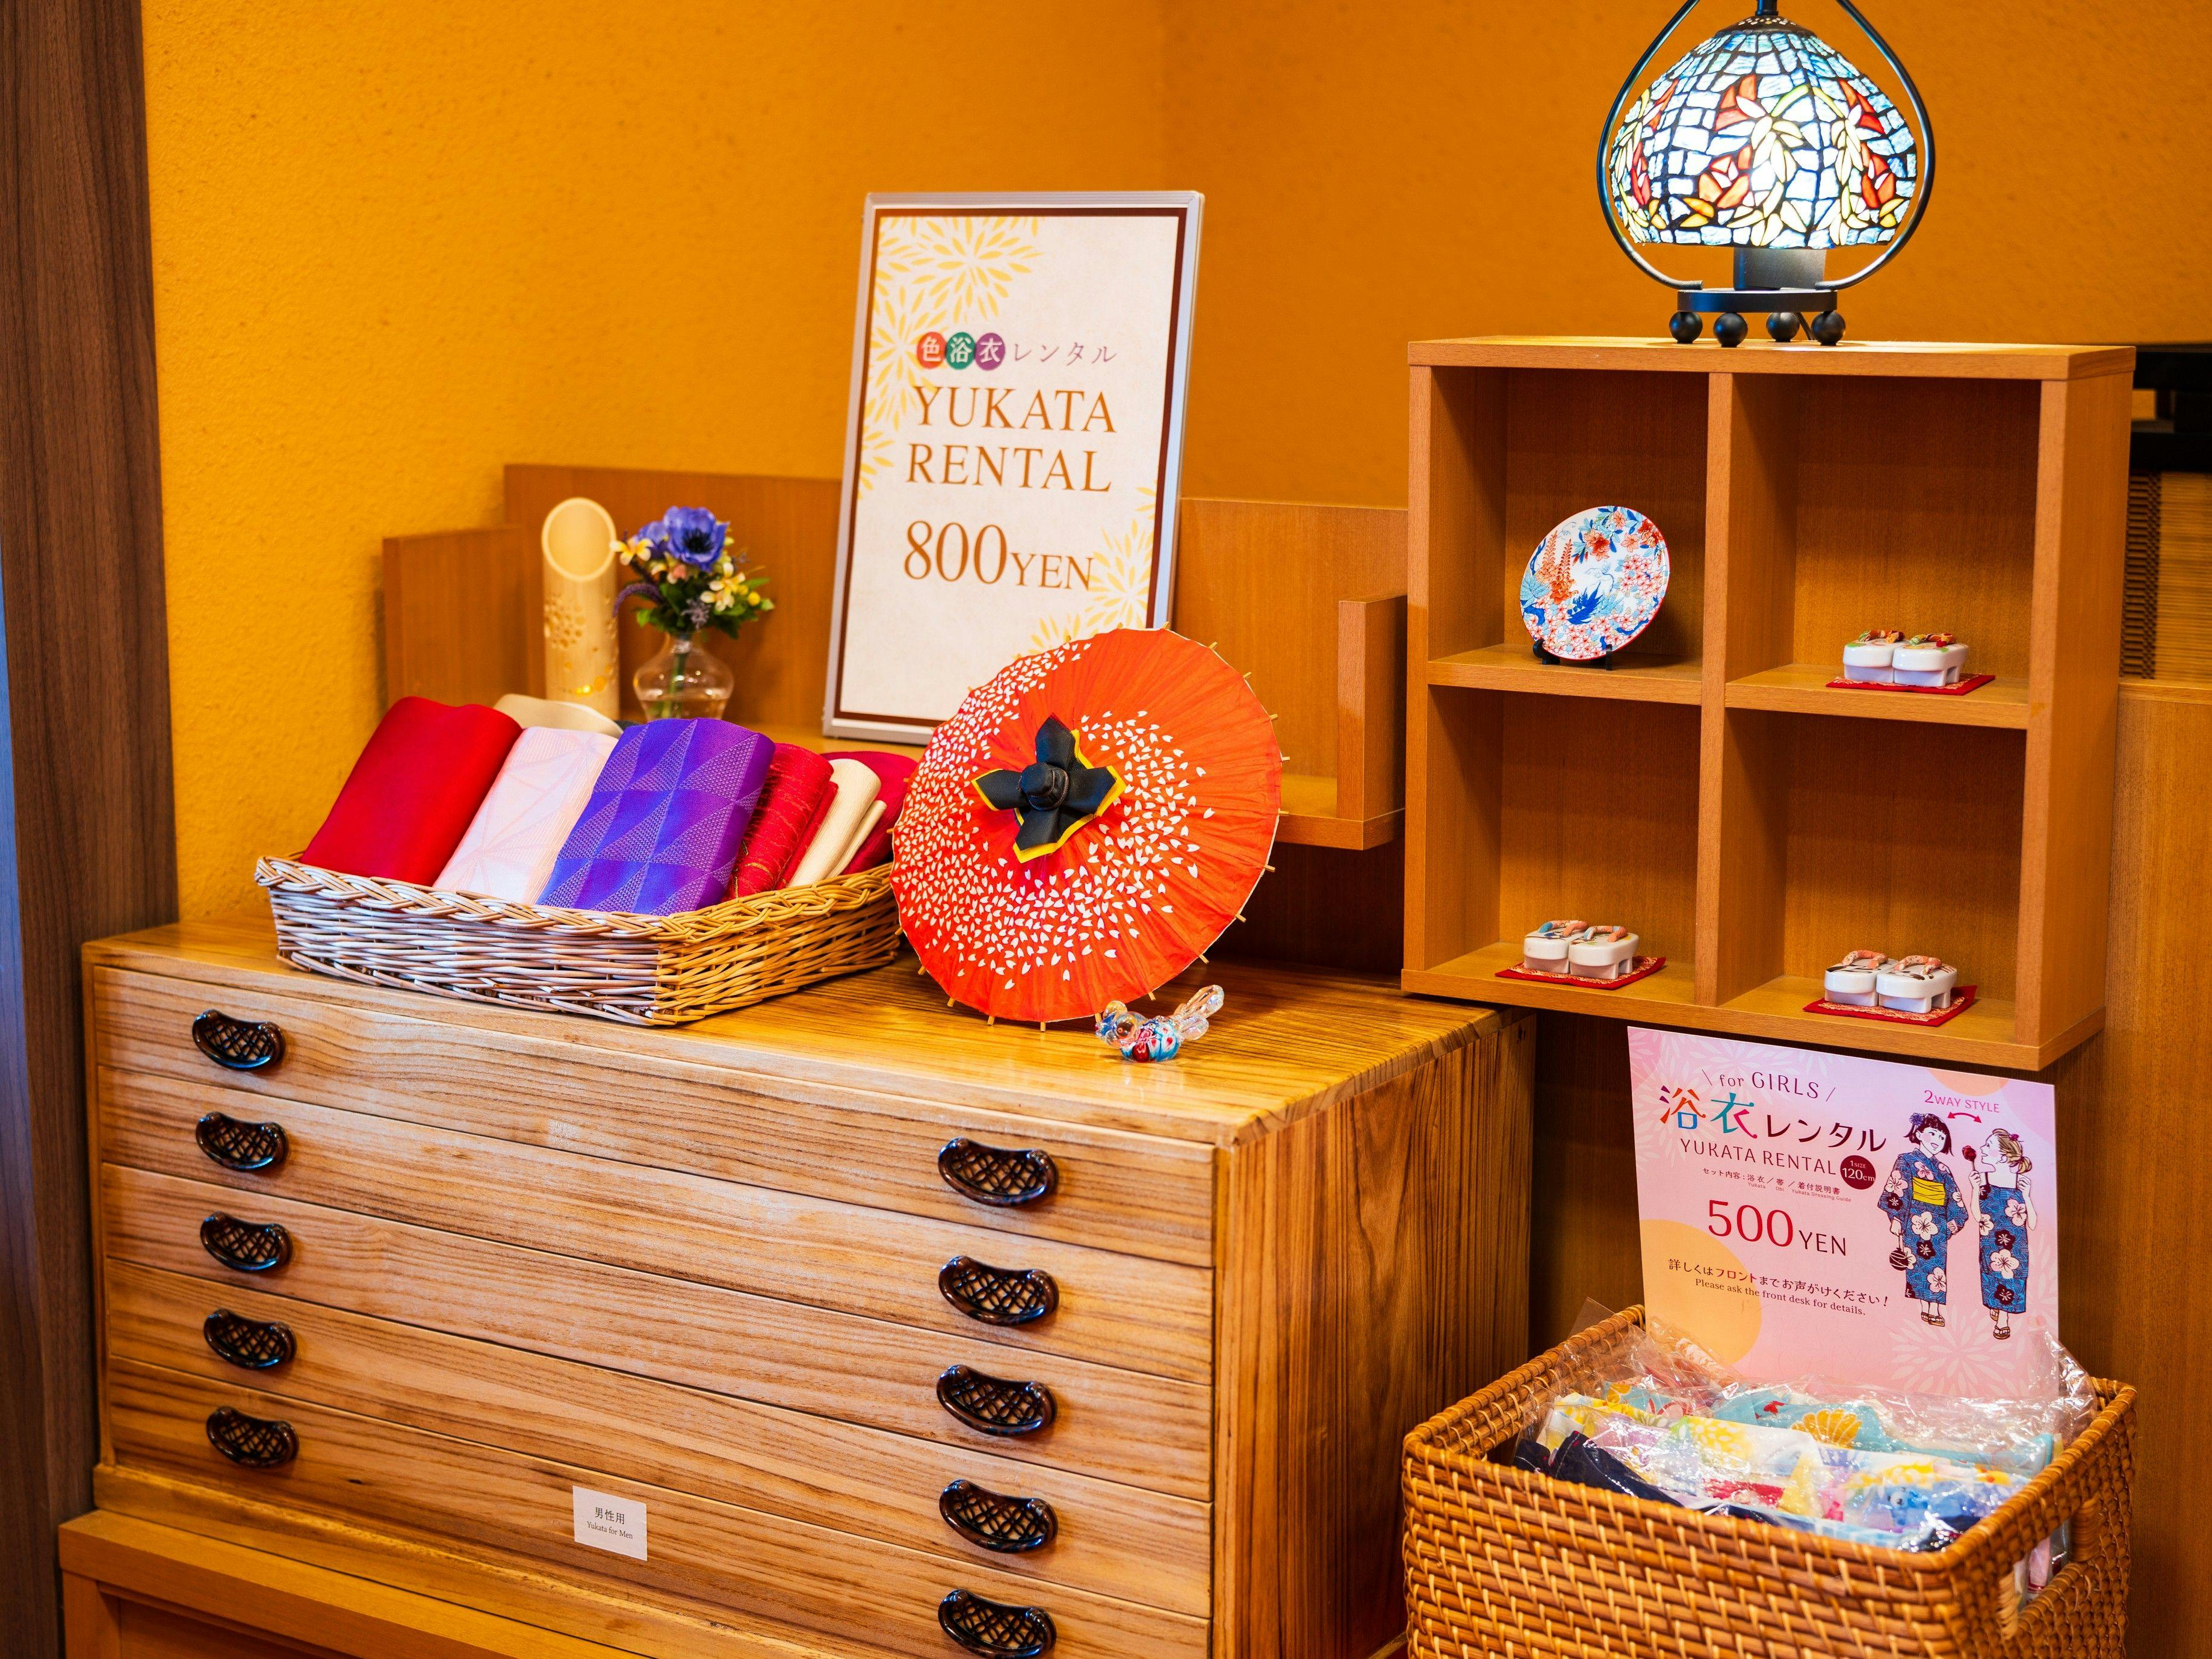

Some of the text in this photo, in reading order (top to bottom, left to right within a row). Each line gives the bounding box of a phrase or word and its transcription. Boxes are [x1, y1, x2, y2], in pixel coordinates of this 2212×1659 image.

[920, 336, 1117, 367] 色浴衣レンタル
[914, 386, 1117, 433] YUKATA
[906, 444, 1112, 492] RENTAL
[1719, 1071, 1818, 1099] for GIRLS
[1924, 1090, 2000, 1113] 2WAY STYLE
[1659, 1085, 1886, 1152] 浴衣レンタル
[1680, 1138, 1836, 1175] YUKATA RENTAL
[1842, 1167, 1876, 1182] 120cm
[1811, 1192, 1835, 1200] Dressing
[1708, 1200, 1846, 1256] 500 YEN
[1696, 1278, 1866, 1316] Please ask the front desk for details.
[587, 1521, 633, 1539] Yukata for Men
[595, 1507, 625, 1525] 男性用
